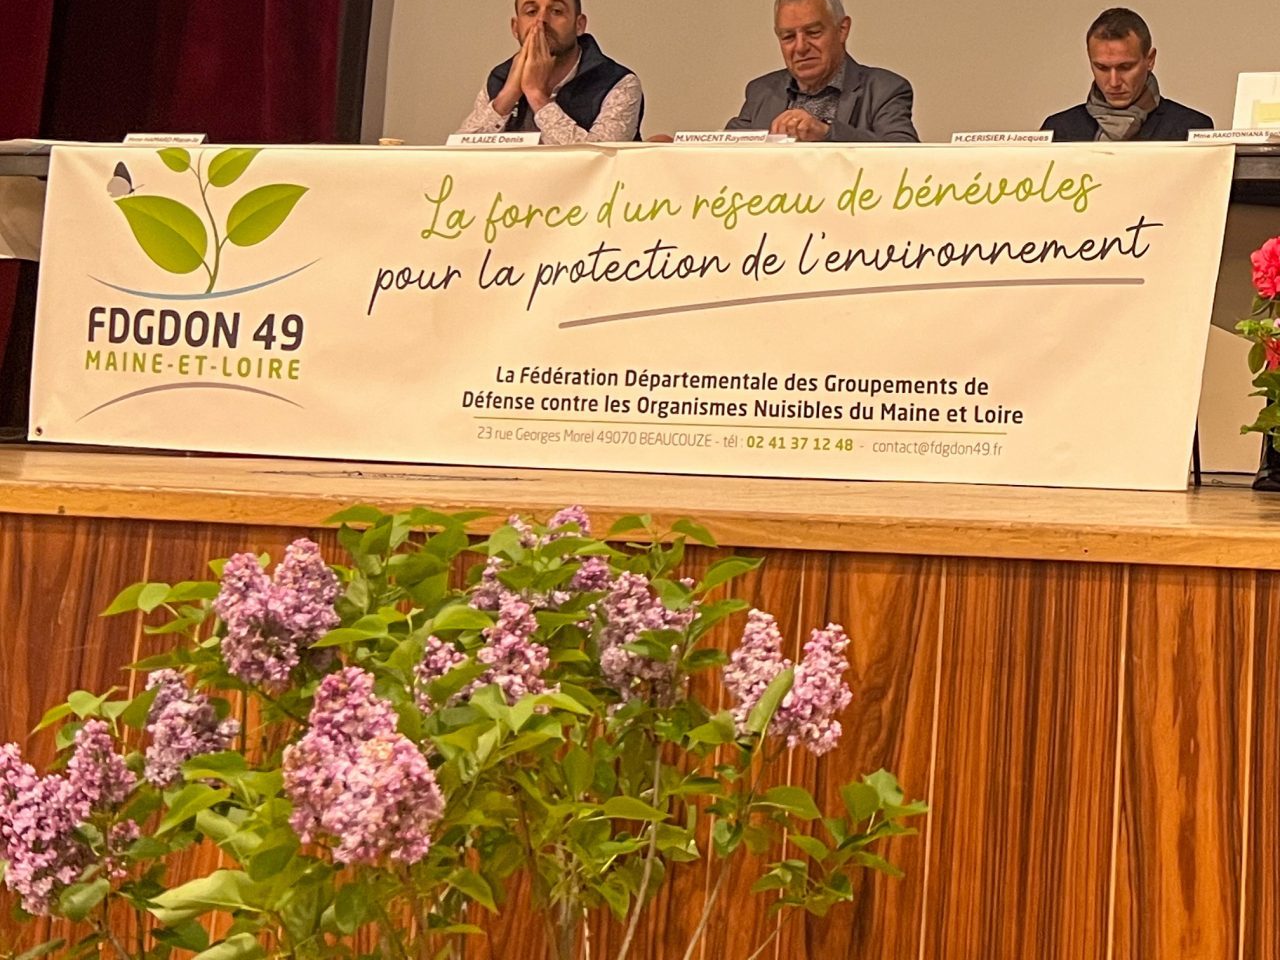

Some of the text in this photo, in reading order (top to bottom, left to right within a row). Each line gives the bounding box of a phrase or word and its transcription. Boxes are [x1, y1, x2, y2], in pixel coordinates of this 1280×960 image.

[498, 135, 524, 144] Denis
[420, 159, 1103, 244] La force d'un réseau de bénévoles
[367, 215, 1164, 316] pour la protection de l'environnement
[88, 306, 304, 352] FDGDON 49
[85, 349, 300, 380] MAINE-ET-LOIRE
[496, 366, 989, 398] La Fédération Départementale des Groupements de
[462, 390, 1024, 424] Défense contre les Organismes Nuisibles du Maine et Loire
[477, 425, 493, 440] 23
[494, 429, 514, 441] rue
[515, 427, 561, 445] Georges
[563, 428, 595, 444] Morel
[596, 430, 637, 445] 49070
[639, 431, 712, 448] BEAUCOUZE
[723, 434, 738, 448] tél
[746, 435, 765, 449] 02
[768, 436, 786, 450] 41
[790, 436, 809, 450] 37
[813, 437, 831, 451] 12
[834, 438, 854, 452] 48
[872, 440, 1003, 458] contact@fdgdon49.fr
